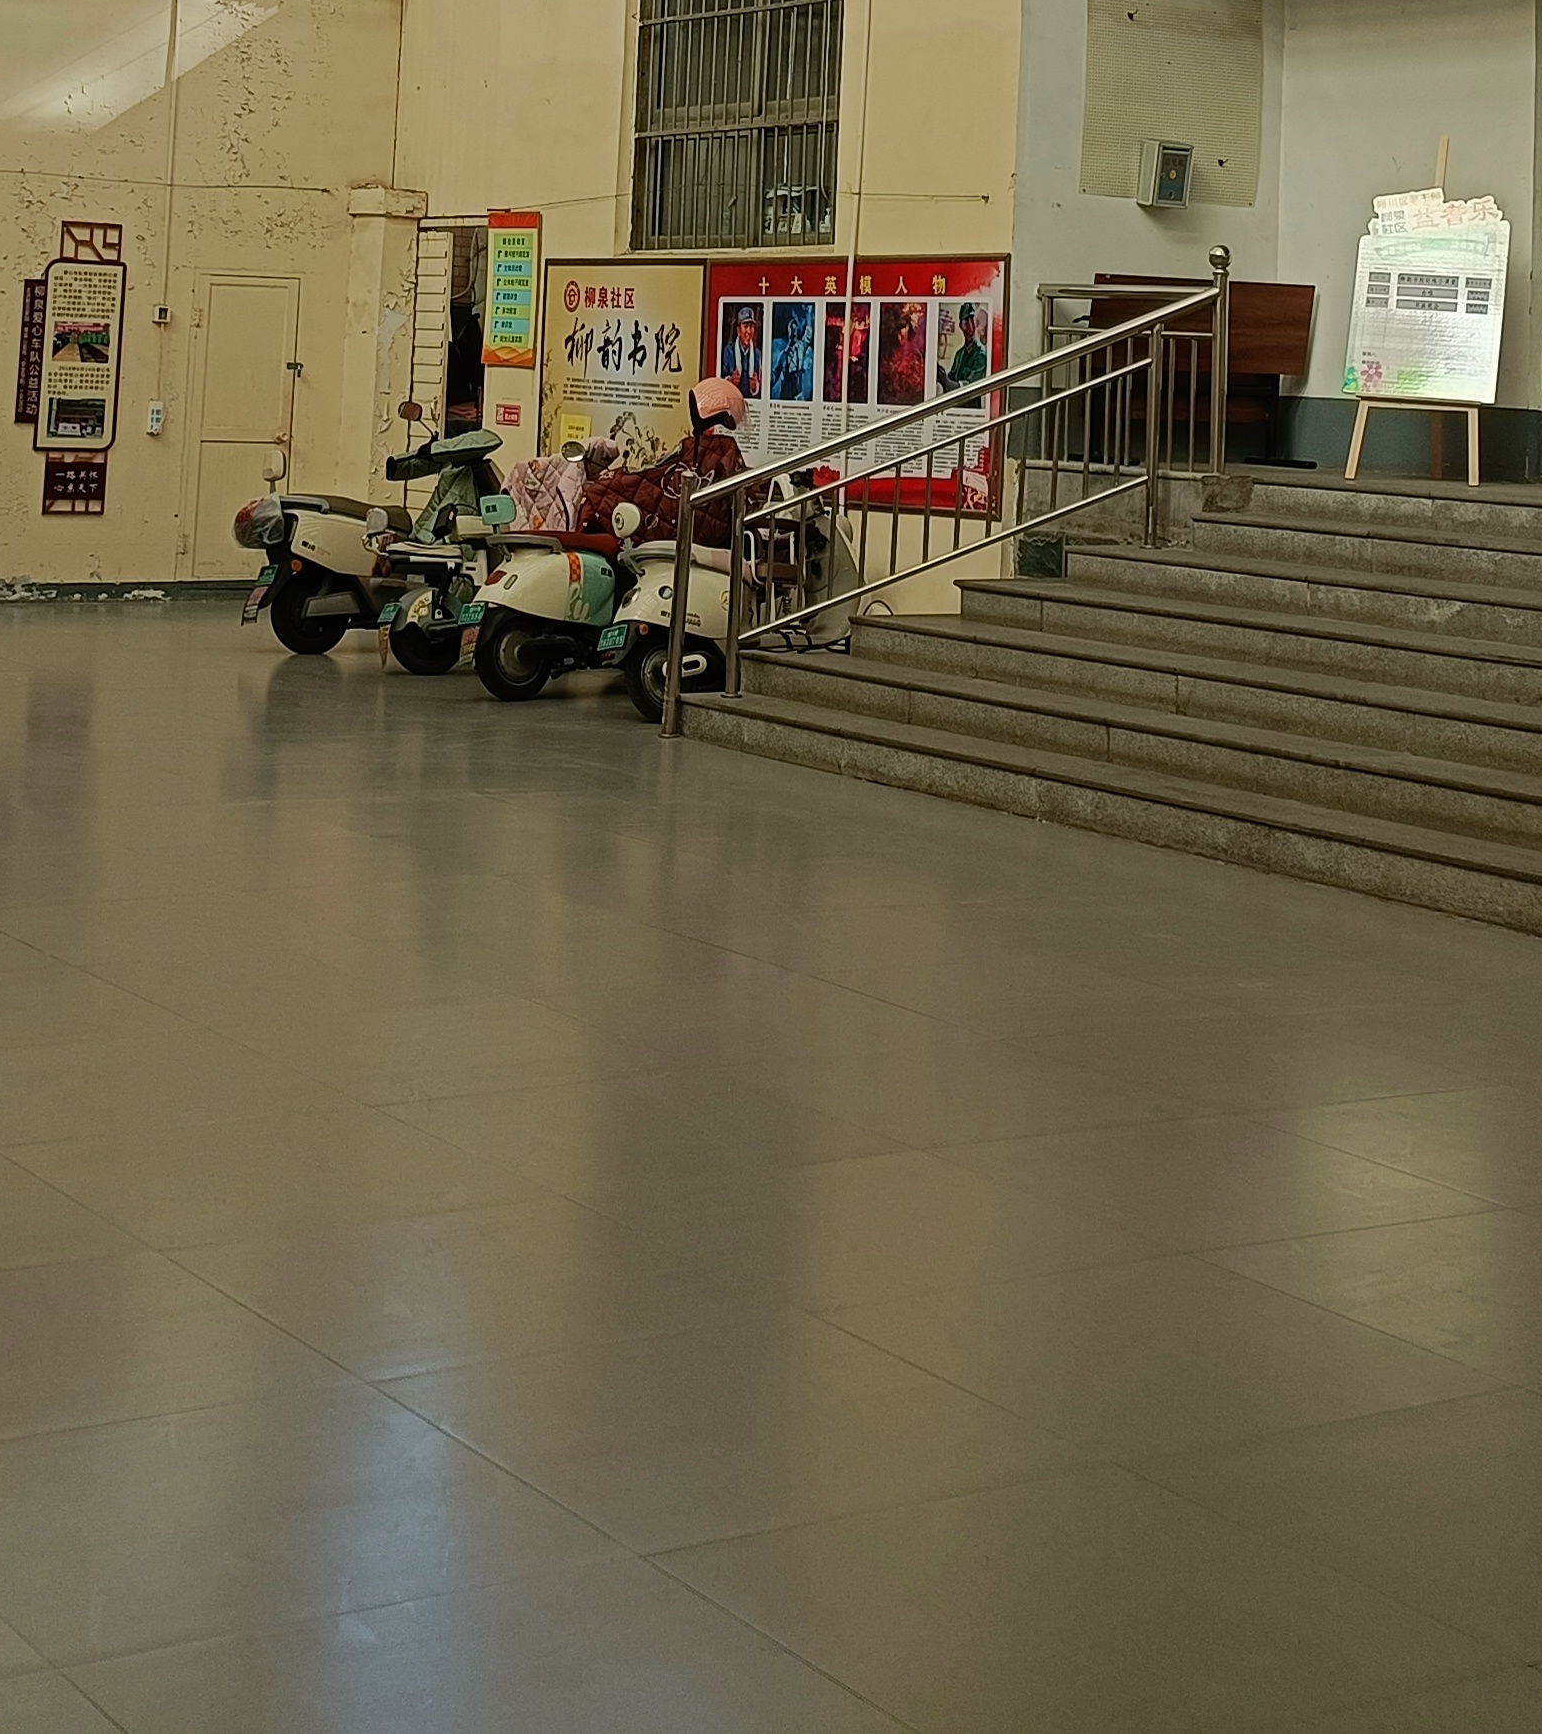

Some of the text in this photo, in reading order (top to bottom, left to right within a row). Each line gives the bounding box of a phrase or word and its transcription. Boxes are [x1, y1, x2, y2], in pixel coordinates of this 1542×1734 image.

[758, 275, 947, 295] 十大英模人物
[584, 286, 635, 309] 柳泉社区
[25, 285, 46, 416] 柳泉爱心车队公益活动
